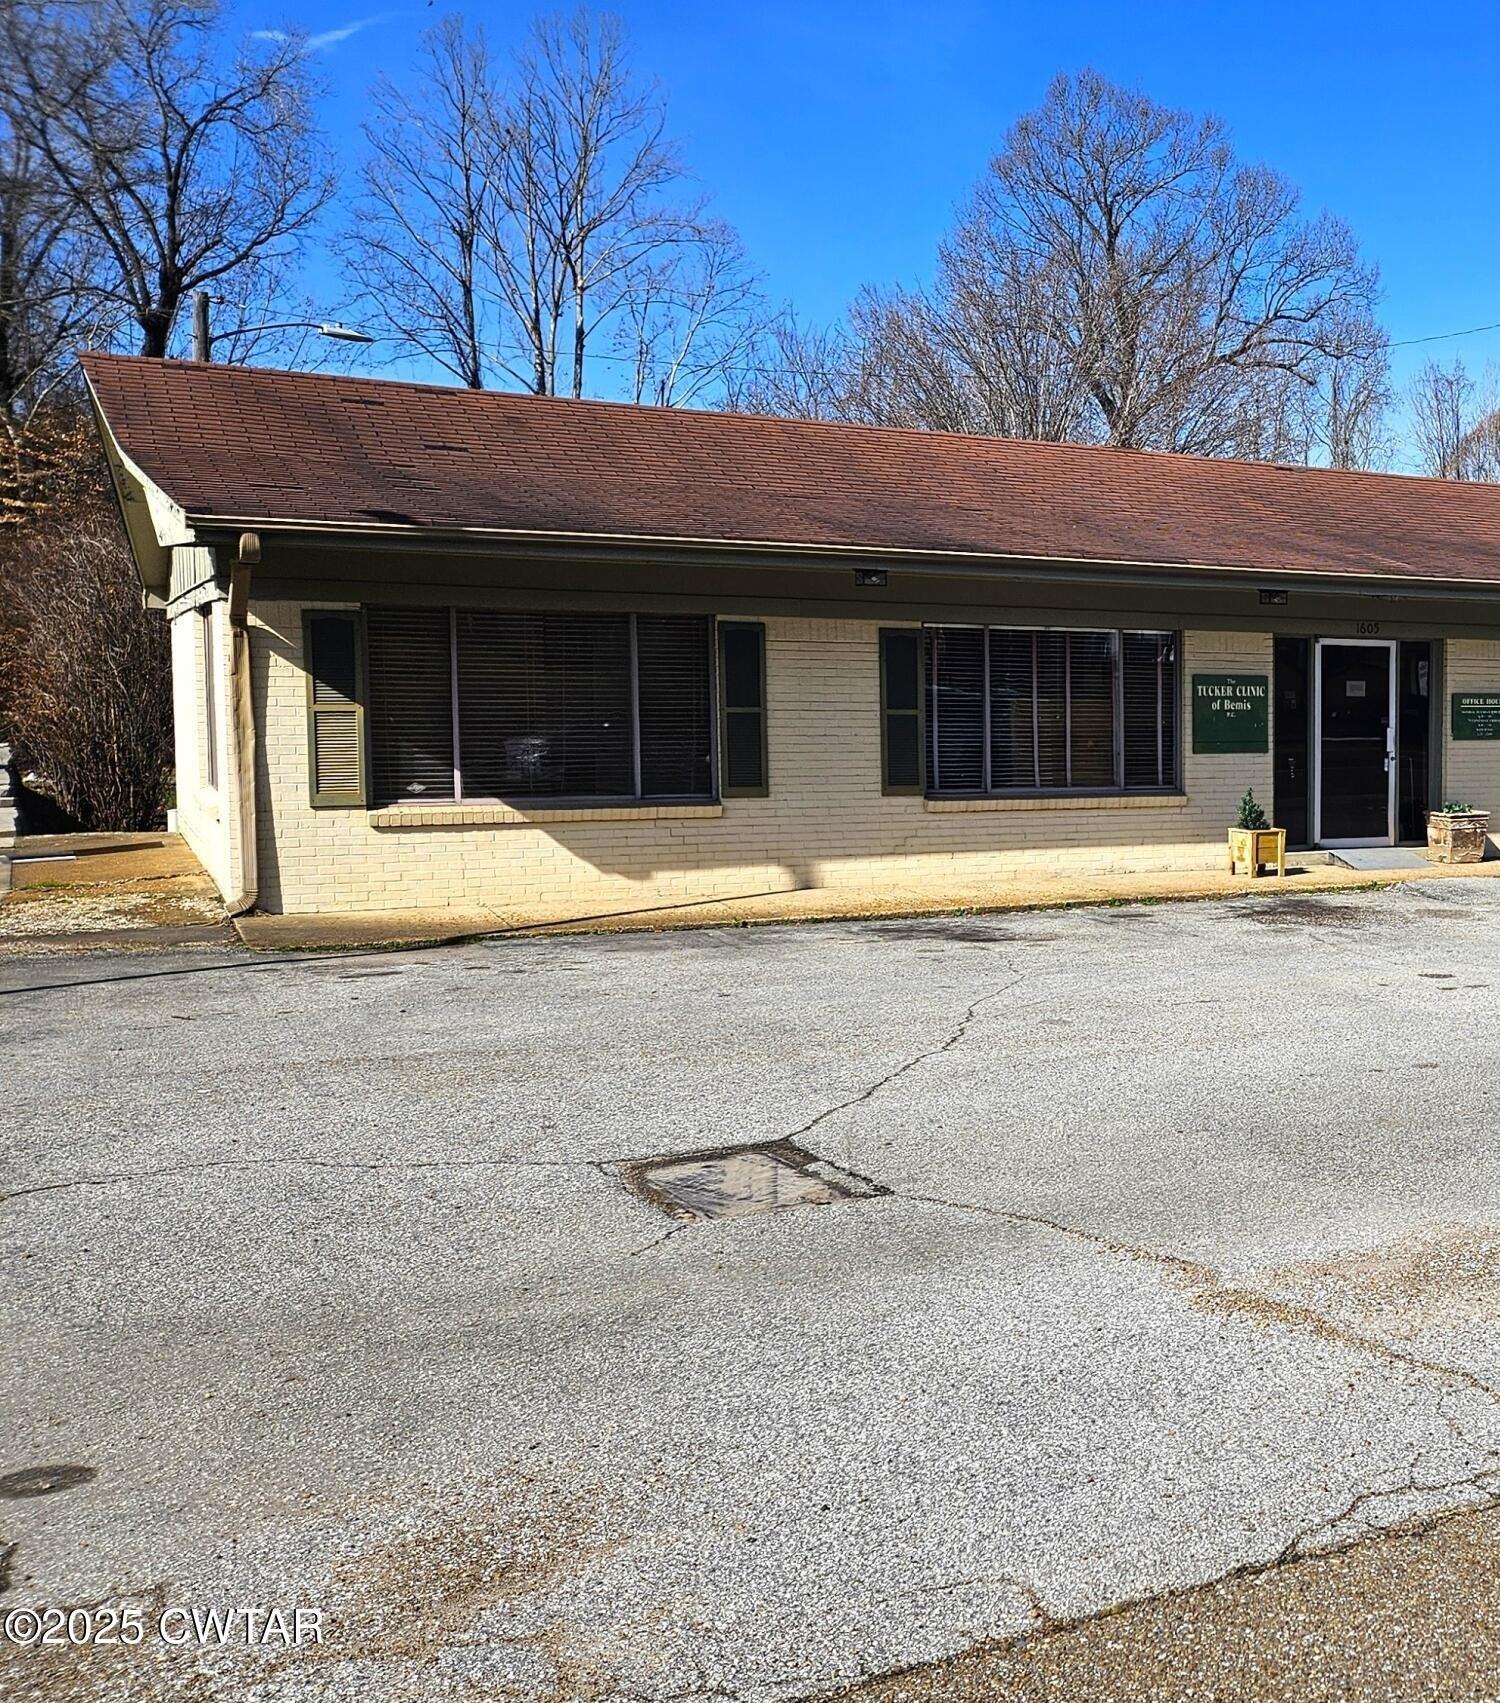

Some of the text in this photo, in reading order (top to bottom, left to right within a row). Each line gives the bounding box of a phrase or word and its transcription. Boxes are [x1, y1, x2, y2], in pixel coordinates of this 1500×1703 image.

[1356, 622, 1380, 634] 1605
[1197, 685, 1266, 697] TUCKER CLINIC
[1211, 699, 1251, 710] of Bemis
